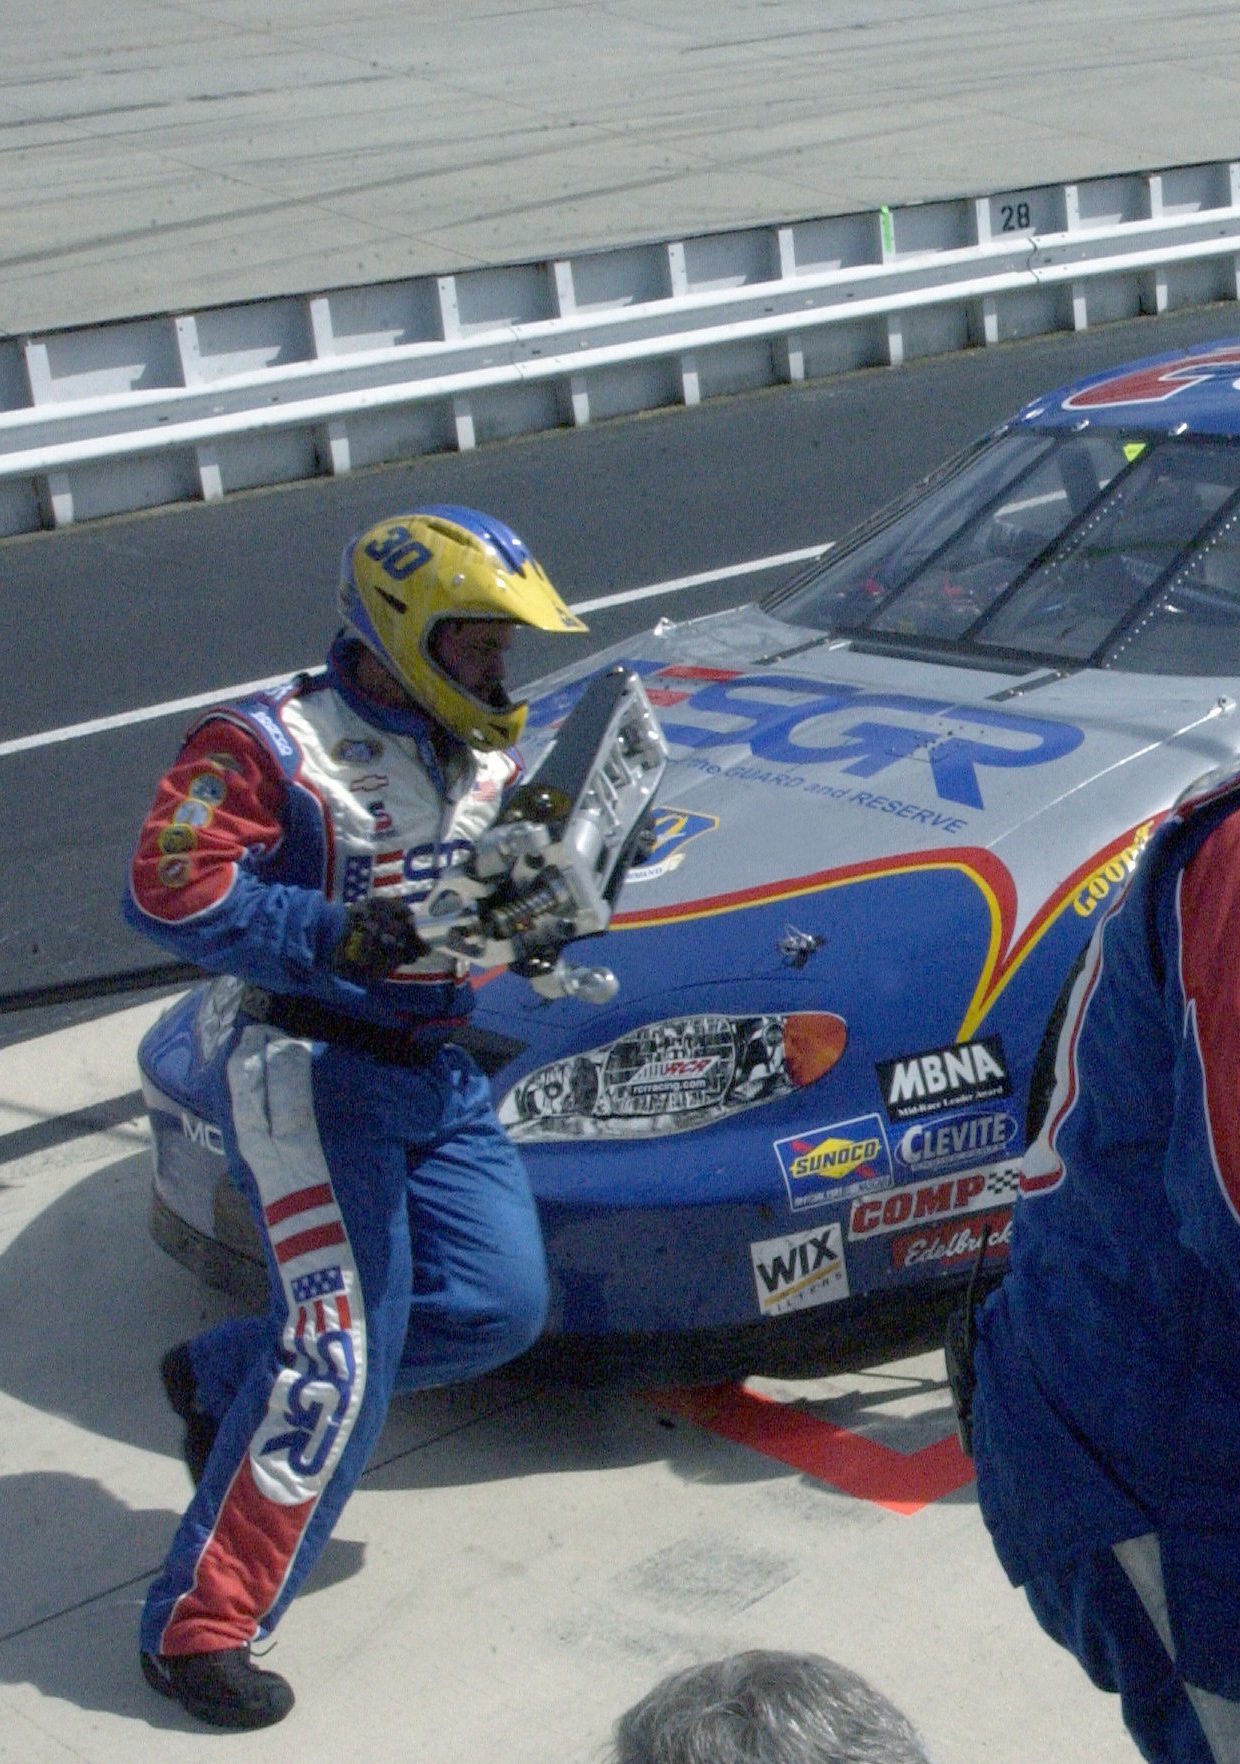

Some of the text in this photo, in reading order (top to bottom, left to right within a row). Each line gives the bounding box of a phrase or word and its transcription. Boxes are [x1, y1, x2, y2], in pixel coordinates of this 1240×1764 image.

[1001, 203, 1031, 231] 28
[364, 526, 432, 581] 30
[724, 765, 804, 787] GUARD
[804, 782, 847, 801] and
[849, 791, 969, 835] RESERVE
[889, 1044, 1005, 1104] MBNA
[795, 1141, 877, 1175] SUNOCO
[902, 1112, 1008, 1164] CLEVITE
[851, 1174, 986, 1234] COMP
[757, 1230, 837, 1293] WIX
